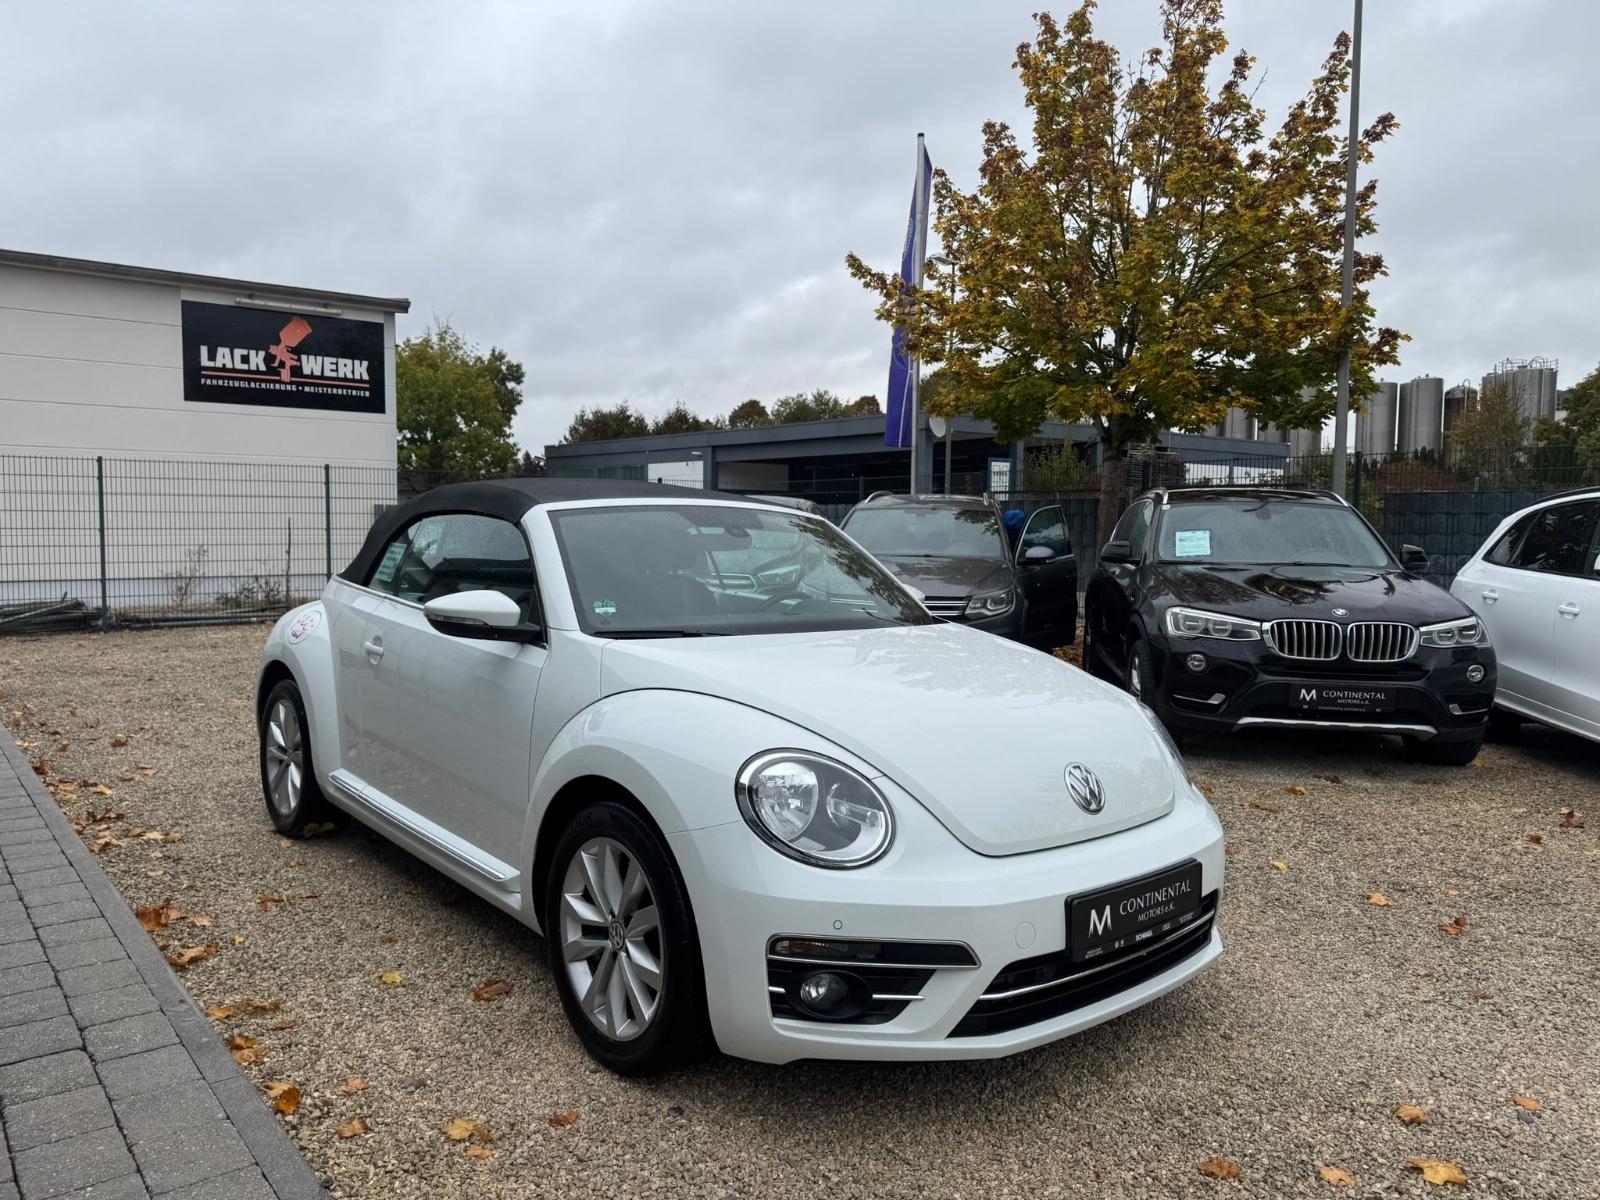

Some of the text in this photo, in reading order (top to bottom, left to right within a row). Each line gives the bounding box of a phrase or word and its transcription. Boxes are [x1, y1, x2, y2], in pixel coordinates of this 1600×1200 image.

[200, 345, 370, 380] LACK WERK
[201, 378, 370, 397] FAHRZEUGLACKIERUNG MEISTERBETRIEB
[1323, 690, 1386, 700] CONTINENTAL
[1119, 879, 1192, 916] CONTINENTAL
[1137, 905, 1165, 922] MOTORS
